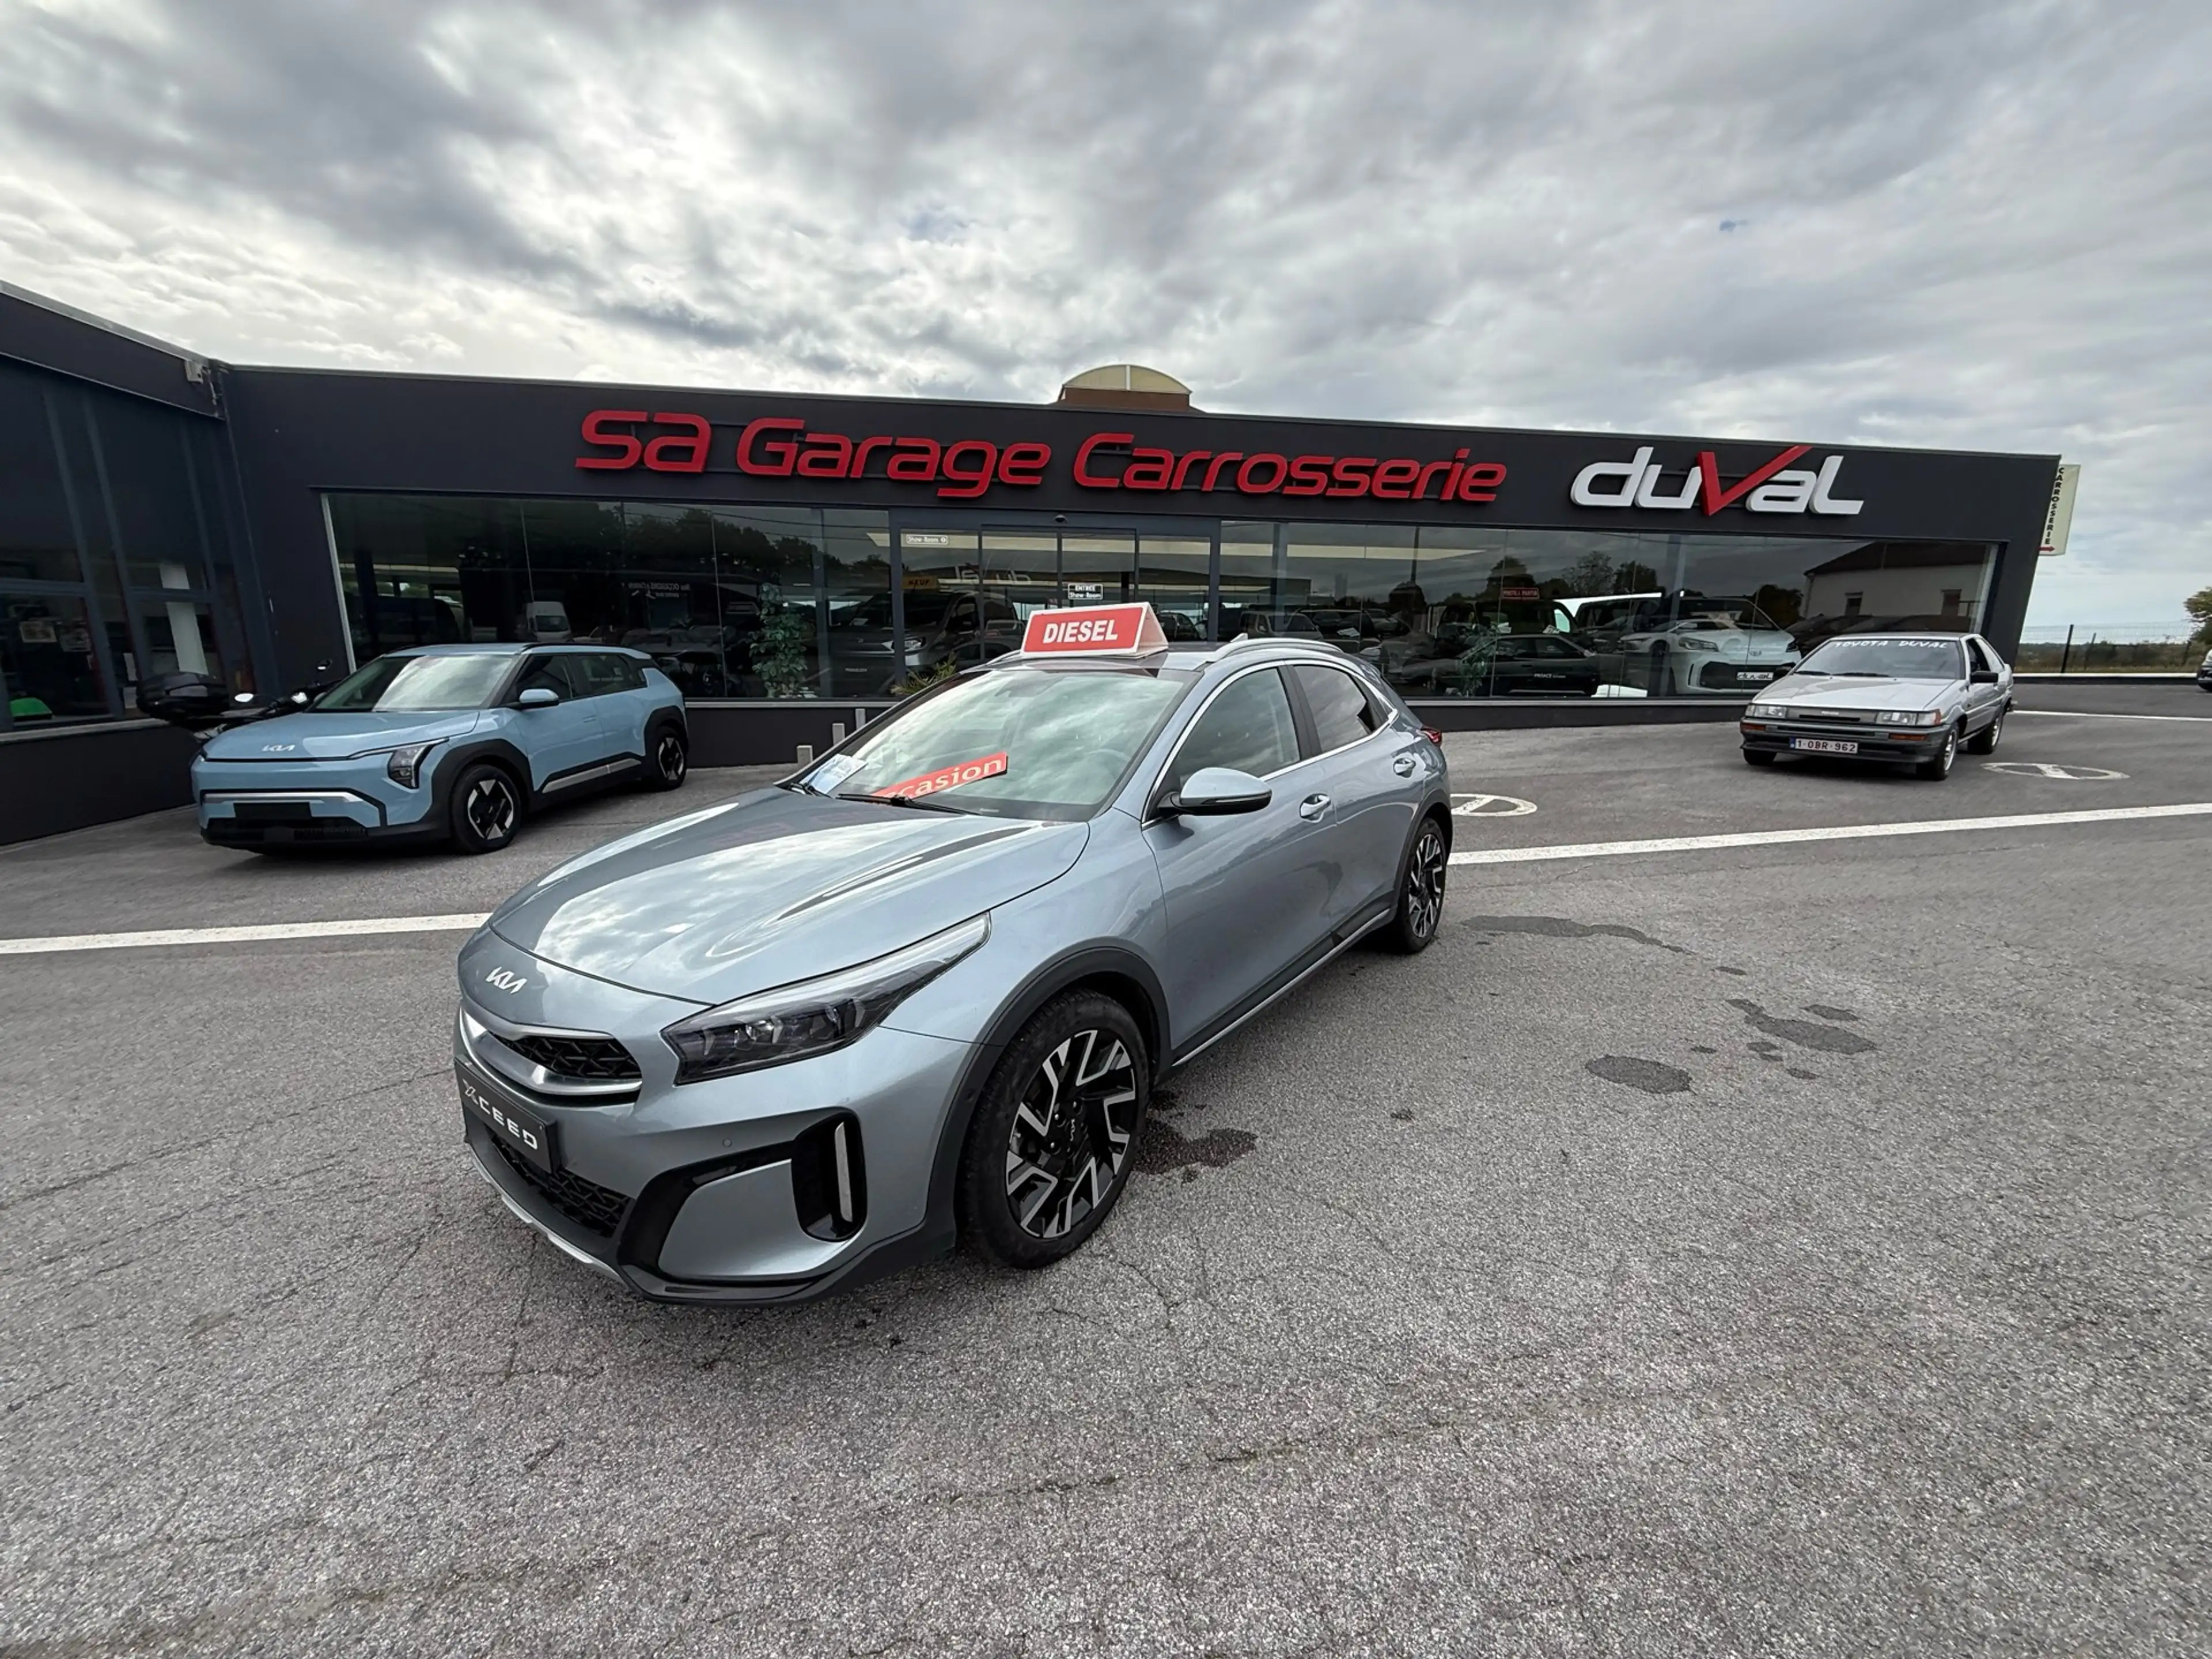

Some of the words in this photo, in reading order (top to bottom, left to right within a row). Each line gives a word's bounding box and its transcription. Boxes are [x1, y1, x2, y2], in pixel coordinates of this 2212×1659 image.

[737, 418, 1051, 498] Garage
[1074, 433, 1507, 501] Carrosserie
[2045, 467, 2065, 544] CARROSSERIE
[1043, 619, 1118, 643] DIESEL
[1898, 640, 1948, 649] DUVAL
[884, 759, 1002, 797] casion
[486, 966, 527, 994] KIA
[462, 1078, 538, 1150] XCEED
